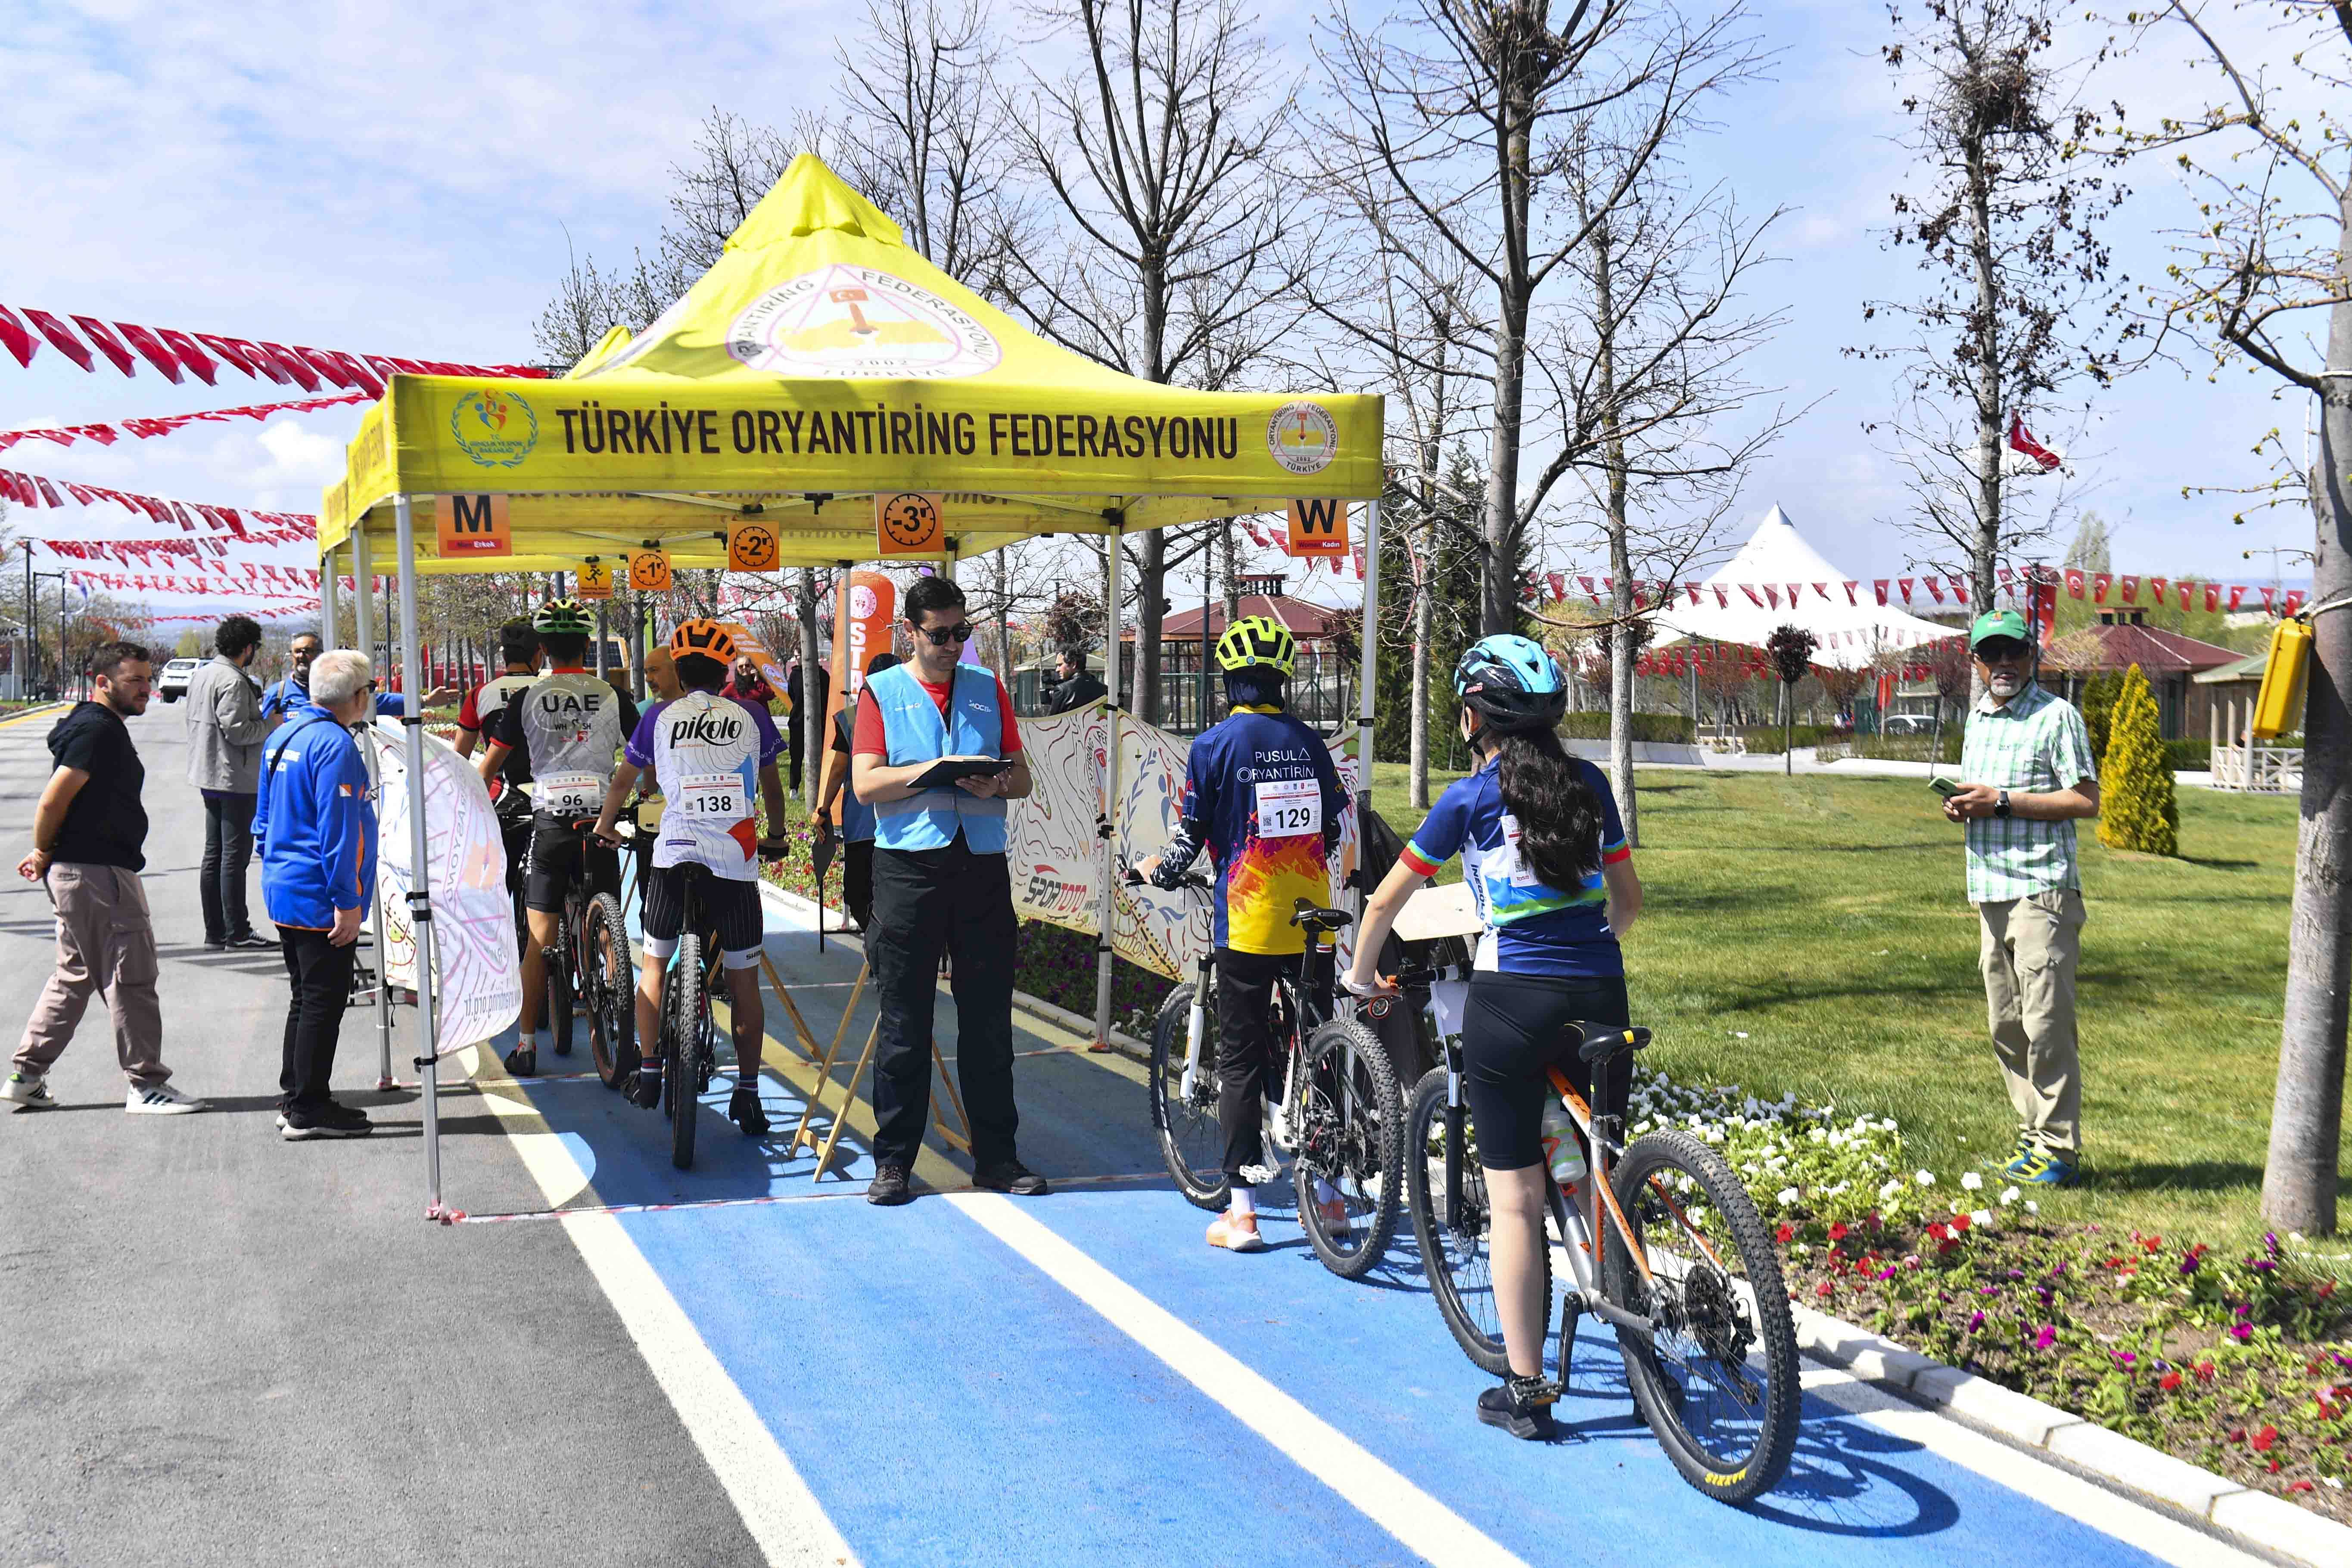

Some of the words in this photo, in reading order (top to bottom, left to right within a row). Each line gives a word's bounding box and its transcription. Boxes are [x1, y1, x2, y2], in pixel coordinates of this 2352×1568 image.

[556, 400, 720, 454] TÜRKİYE
[732, 403, 976, 455] ORYANTİRİNG
[989, 413, 1237, 460] FEDERASYONU
[453, 495, 492, 533] M
[1296, 499, 1337, 533] W
[542, 694, 600, 713] UAE
[670, 712, 742, 750] pikolo
[562, 794, 582, 806] 96
[697, 796, 732, 812] 138
[1276, 807, 1310, 828] 129
